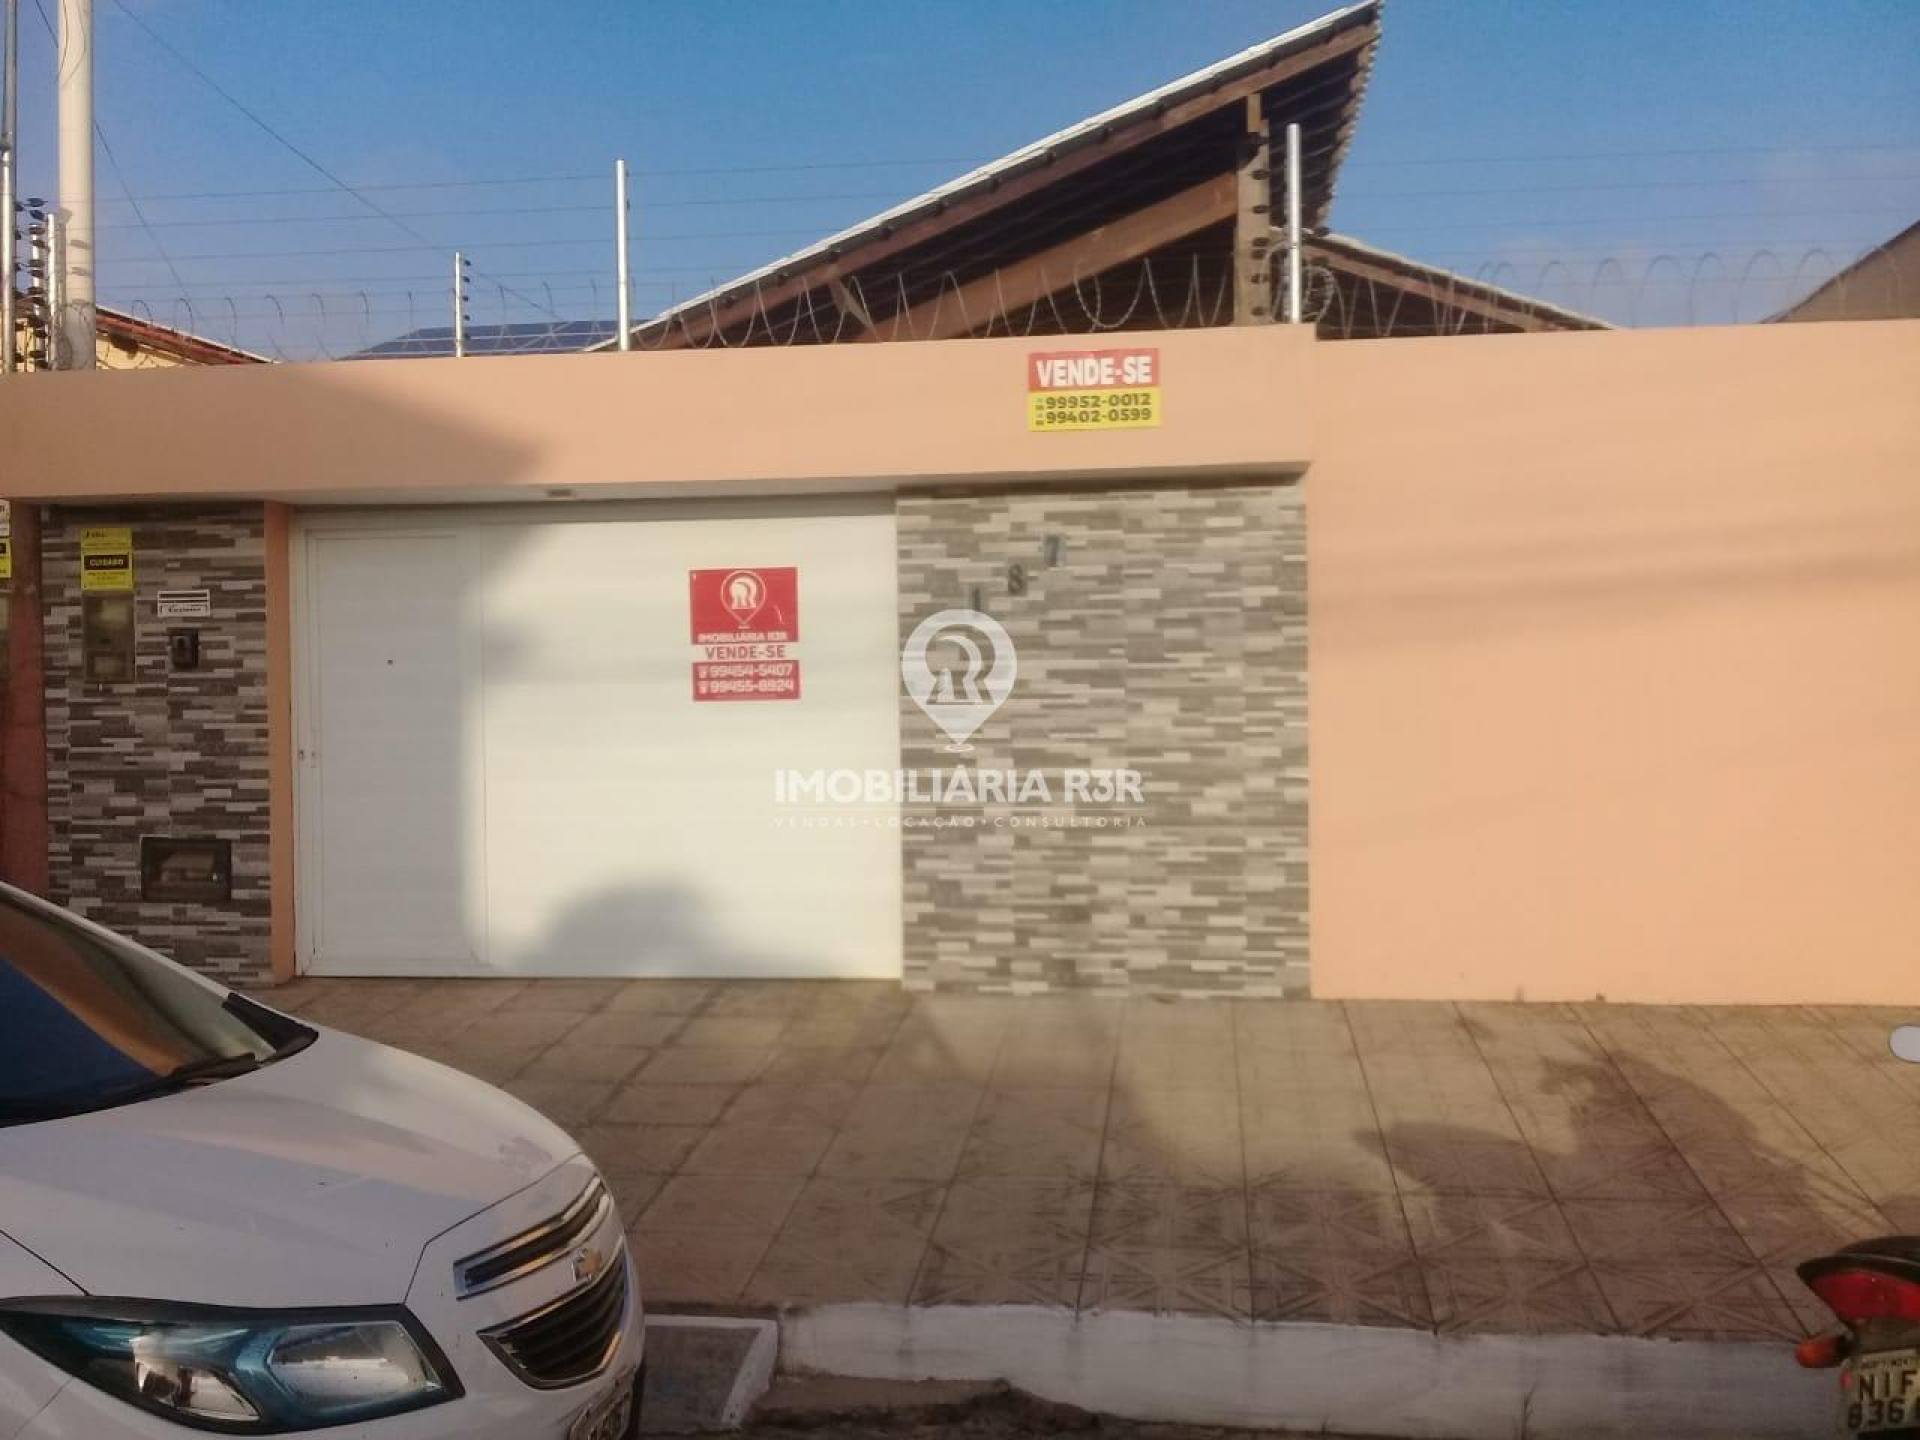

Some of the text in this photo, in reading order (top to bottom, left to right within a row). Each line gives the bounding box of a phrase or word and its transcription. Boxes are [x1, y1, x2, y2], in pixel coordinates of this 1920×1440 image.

[1036, 356, 1152, 388] VENDE-SE
[1045, 393, 1151, 409] 99952-0012
[1045, 408, 1152, 424] 99402-0599
[704, 645, 786, 660] VENDE-SE
